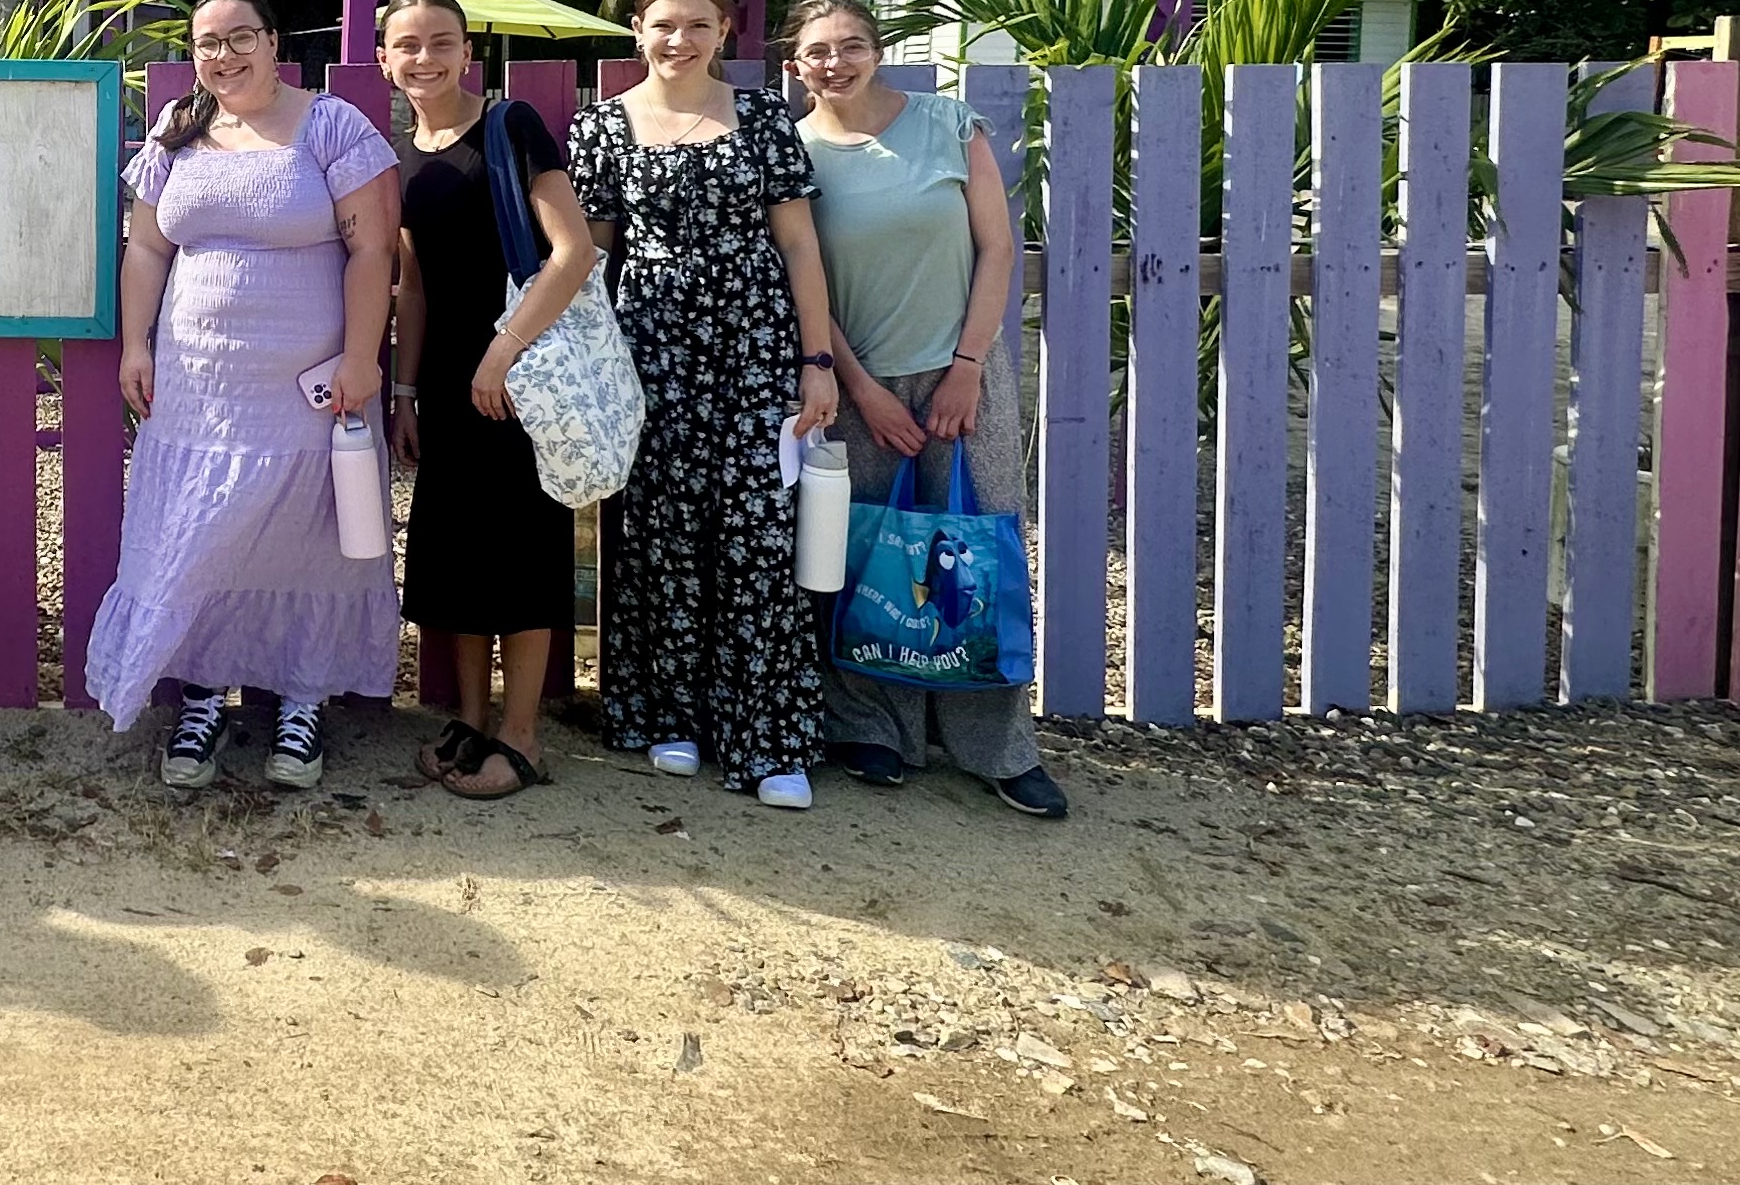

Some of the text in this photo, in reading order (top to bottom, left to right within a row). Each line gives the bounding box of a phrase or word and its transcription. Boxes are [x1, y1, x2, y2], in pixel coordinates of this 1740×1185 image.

[852, 642, 882, 663] CAN
[888, 643, 893, 659] I
[933, 646, 970, 672] YOU?
